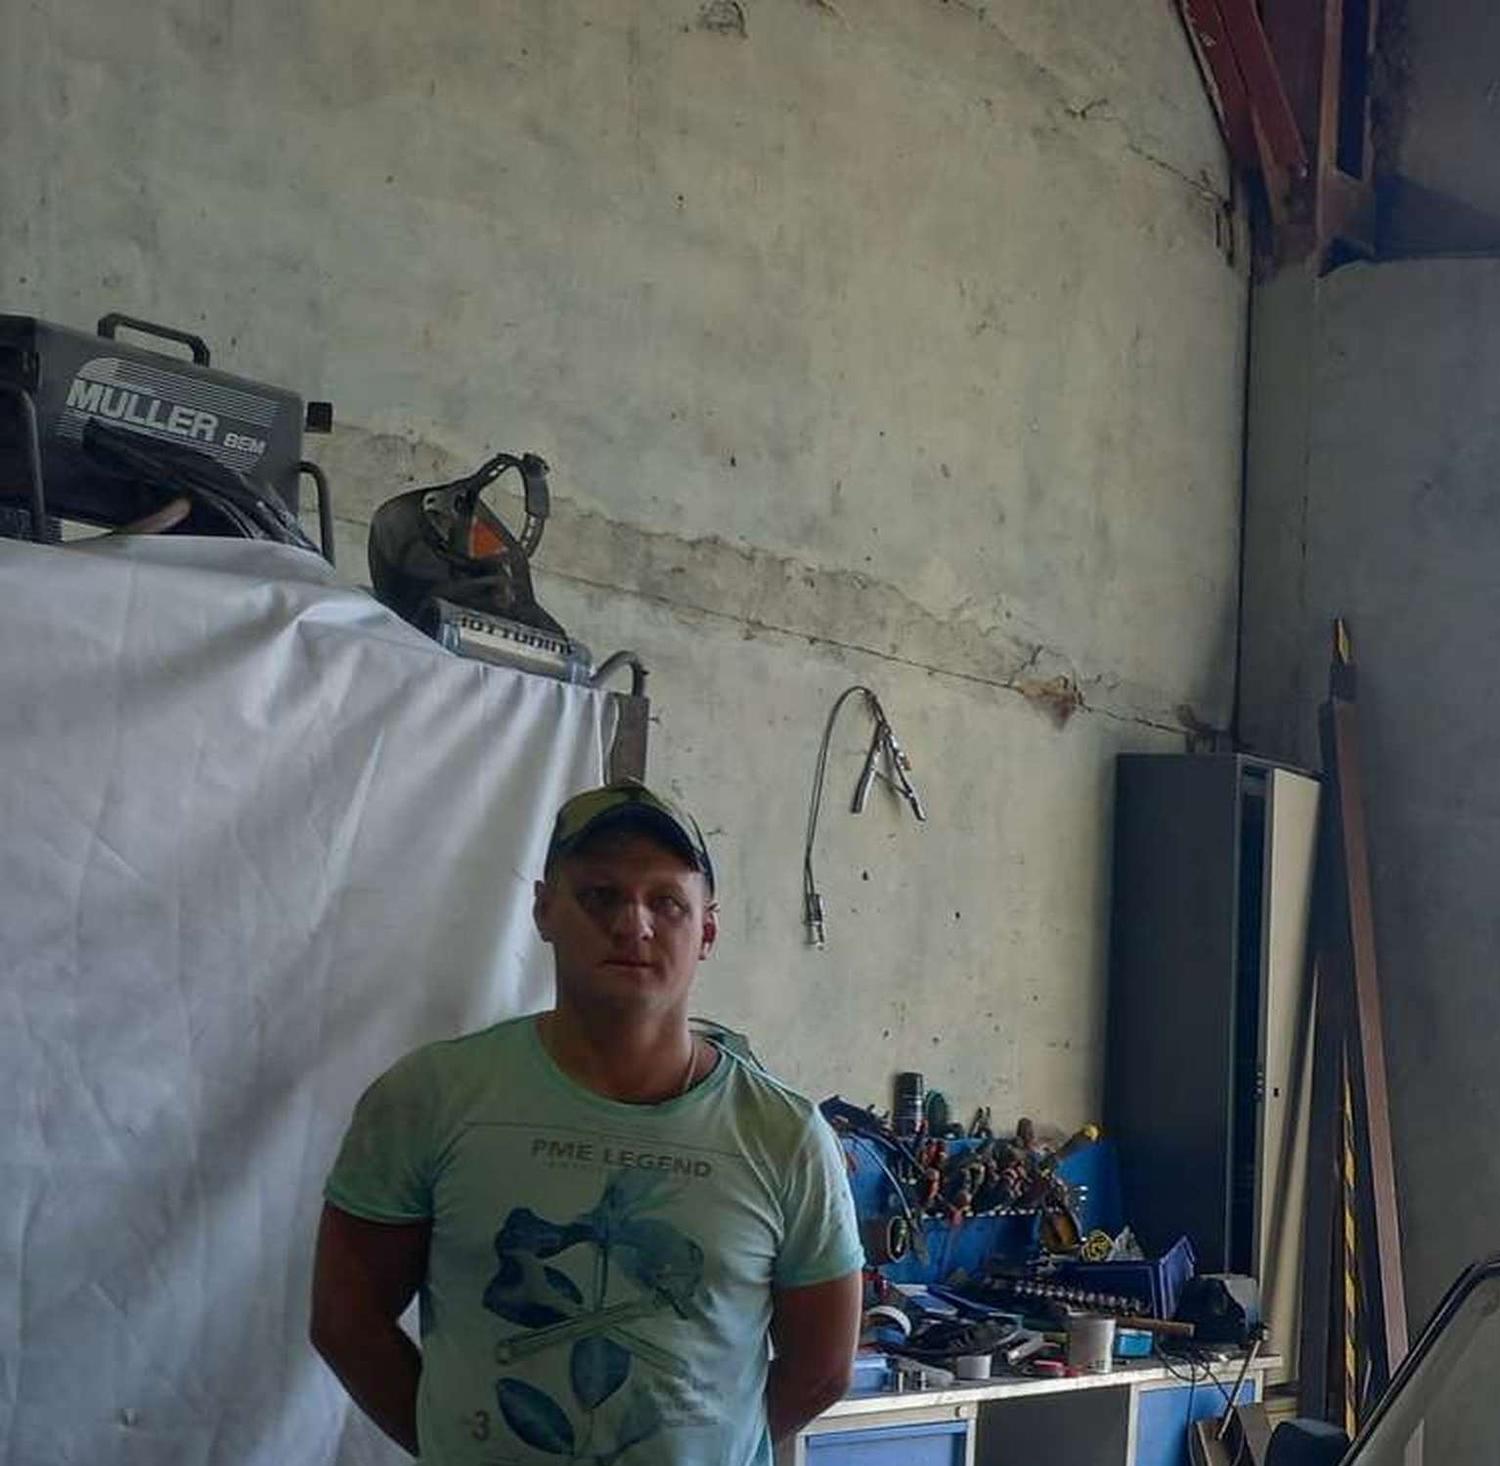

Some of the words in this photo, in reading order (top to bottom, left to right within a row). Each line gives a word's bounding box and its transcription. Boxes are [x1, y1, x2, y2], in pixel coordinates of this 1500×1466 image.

[65, 378, 219, 442] MULLER
[531, 1138, 593, 1162] PME
[603, 1148, 712, 1178] LEGEND
